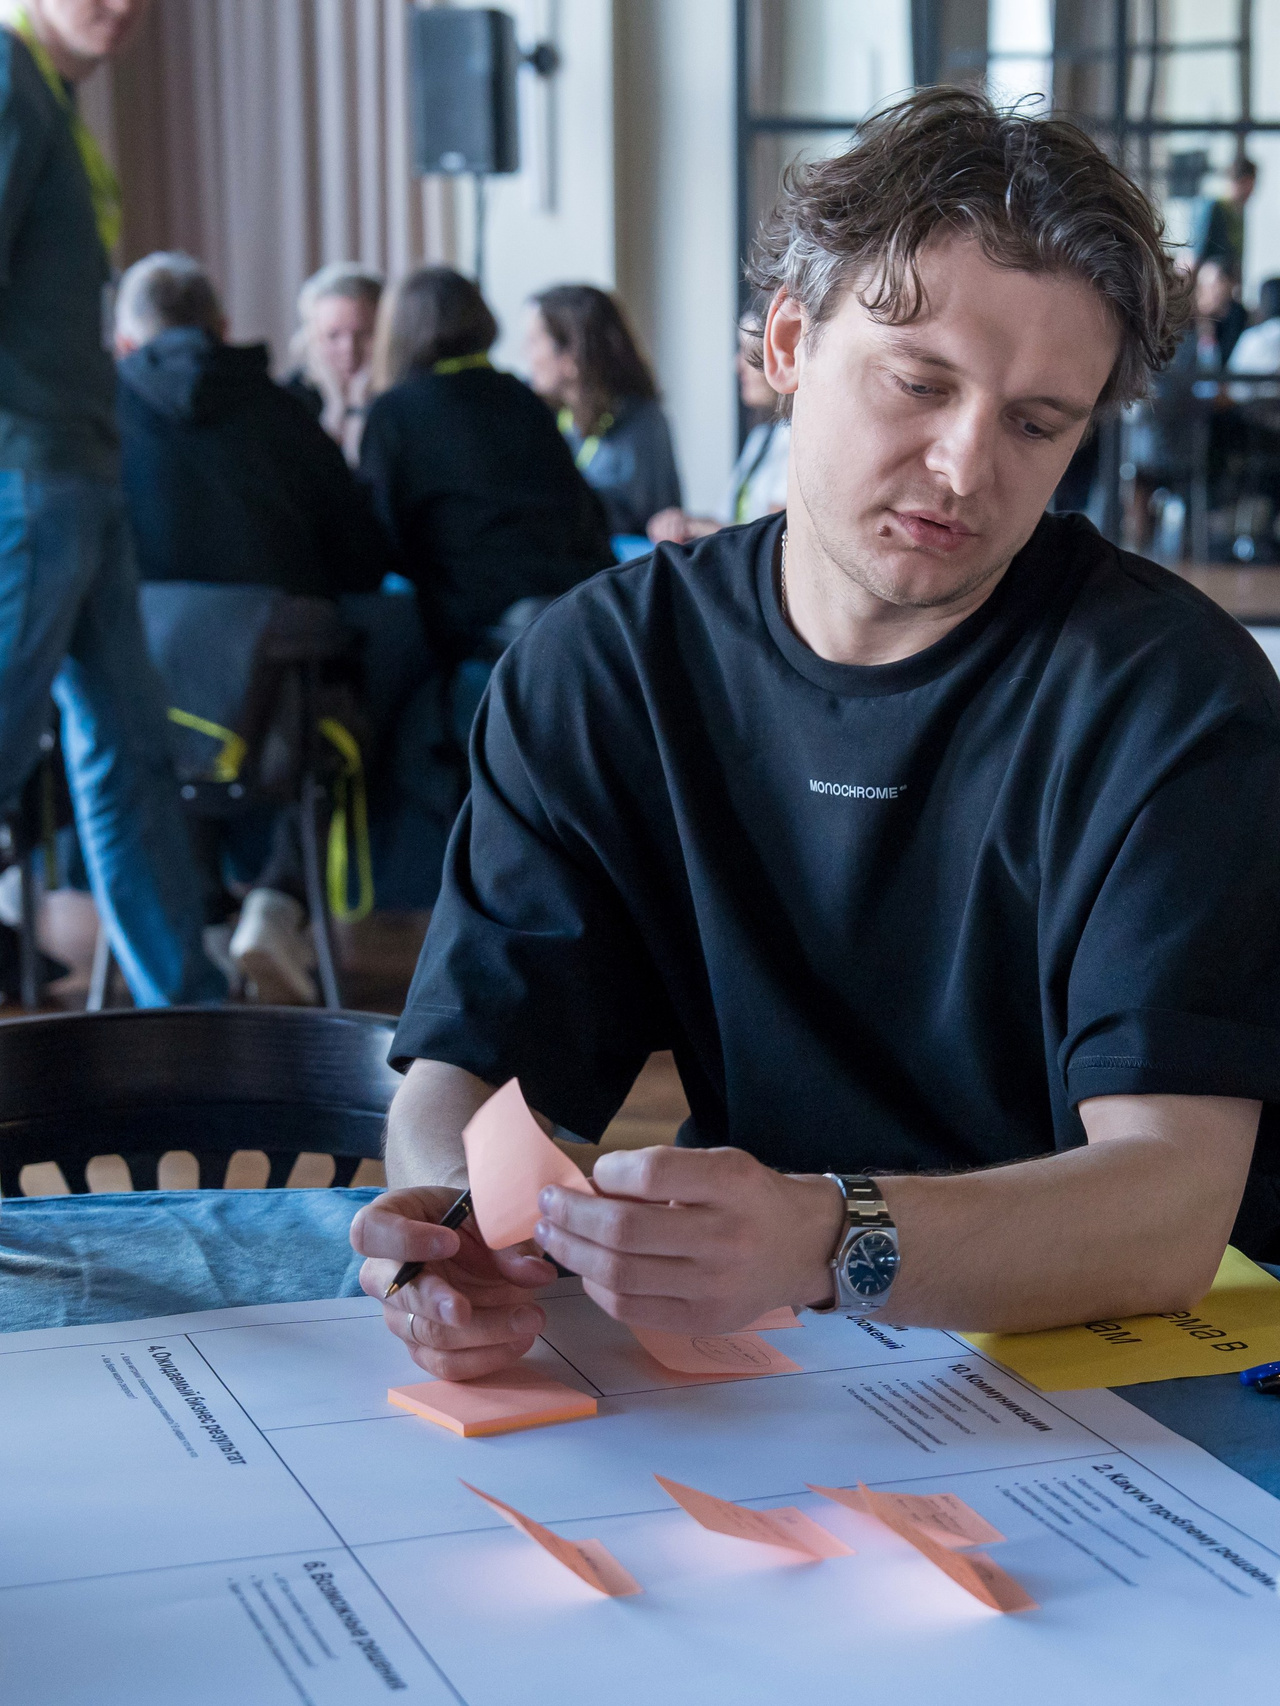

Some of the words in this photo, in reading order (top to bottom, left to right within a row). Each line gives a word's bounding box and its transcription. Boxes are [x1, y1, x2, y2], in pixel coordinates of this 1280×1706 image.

[845, 1315, 906, 1350] ложений
[152, 1351, 201, 1397] Ожидаемый
[184, 1396, 216, 1424] бизнес
[200, 1423, 247, 1465] результат
[961, 1373, 1053, 1432] Коммуникации
[1105, 1472, 1154, 1503] Какую
[1147, 1502, 1220, 1546] проблему
